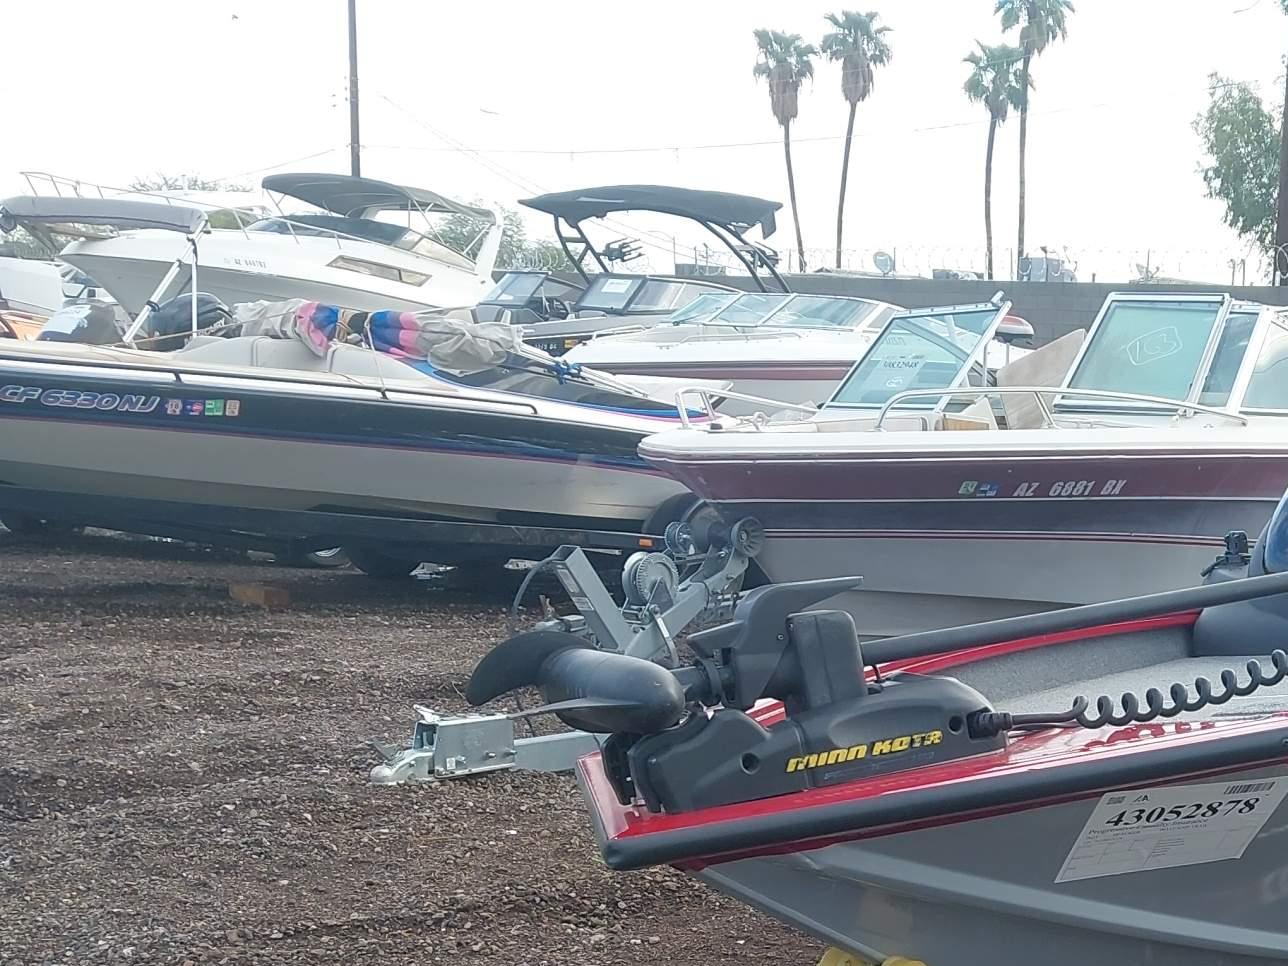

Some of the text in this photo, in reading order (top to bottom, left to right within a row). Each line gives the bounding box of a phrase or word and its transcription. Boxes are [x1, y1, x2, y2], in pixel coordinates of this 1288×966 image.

[0, 384, 41, 402] CF
[1013, 482, 1040, 497] AZ
[1105, 797, 1261, 827] 43052878
